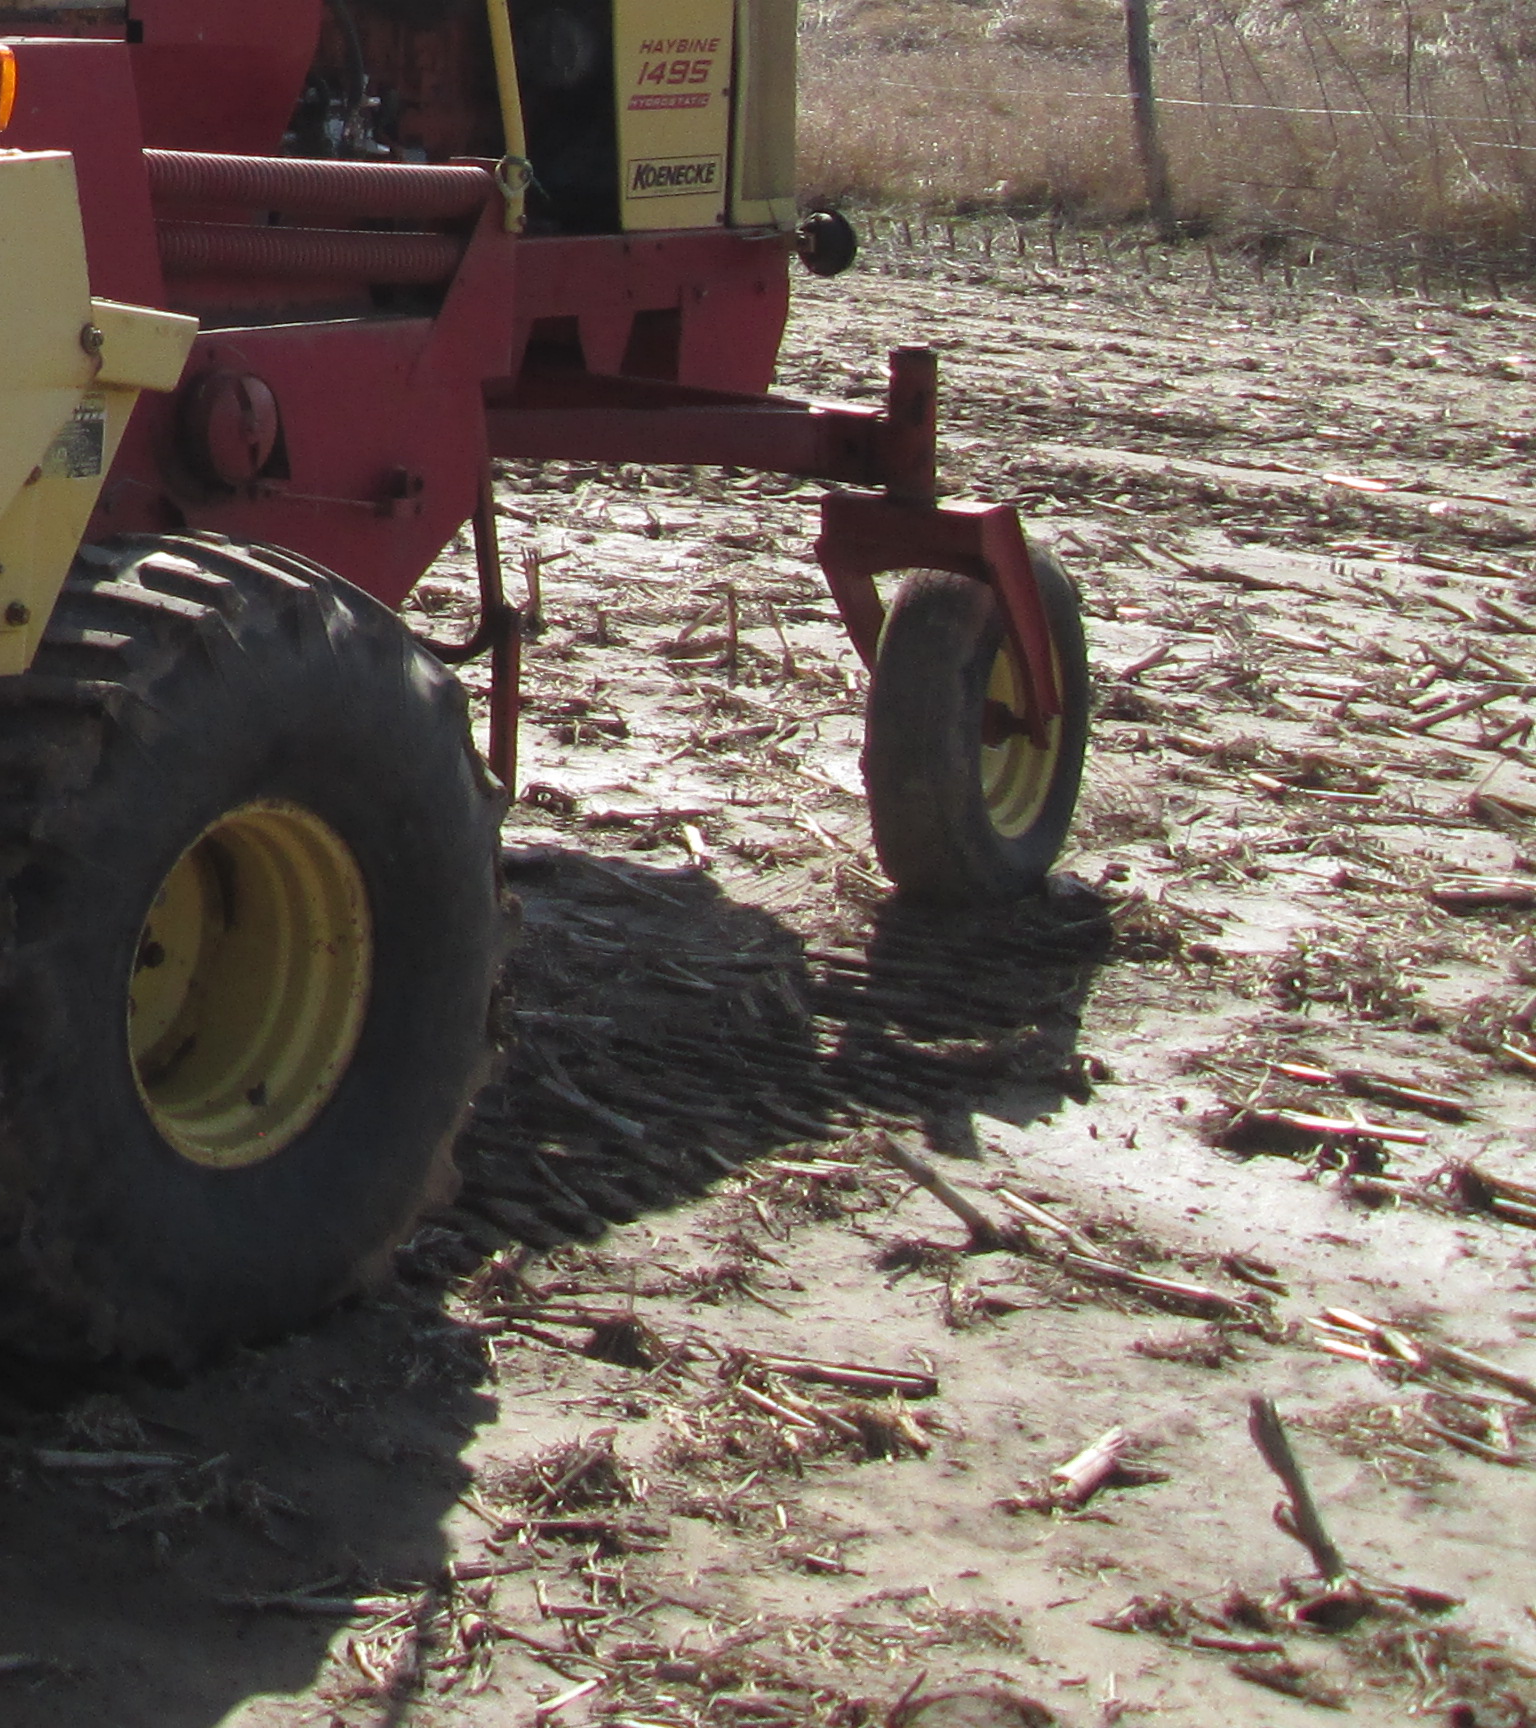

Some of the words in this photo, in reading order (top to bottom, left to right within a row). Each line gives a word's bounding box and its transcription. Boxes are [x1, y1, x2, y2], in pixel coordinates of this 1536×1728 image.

[639, 37, 721, 54] HAYBINE
[637, 59, 714, 85] 1495
[632, 162, 716, 191] KOENECKE
